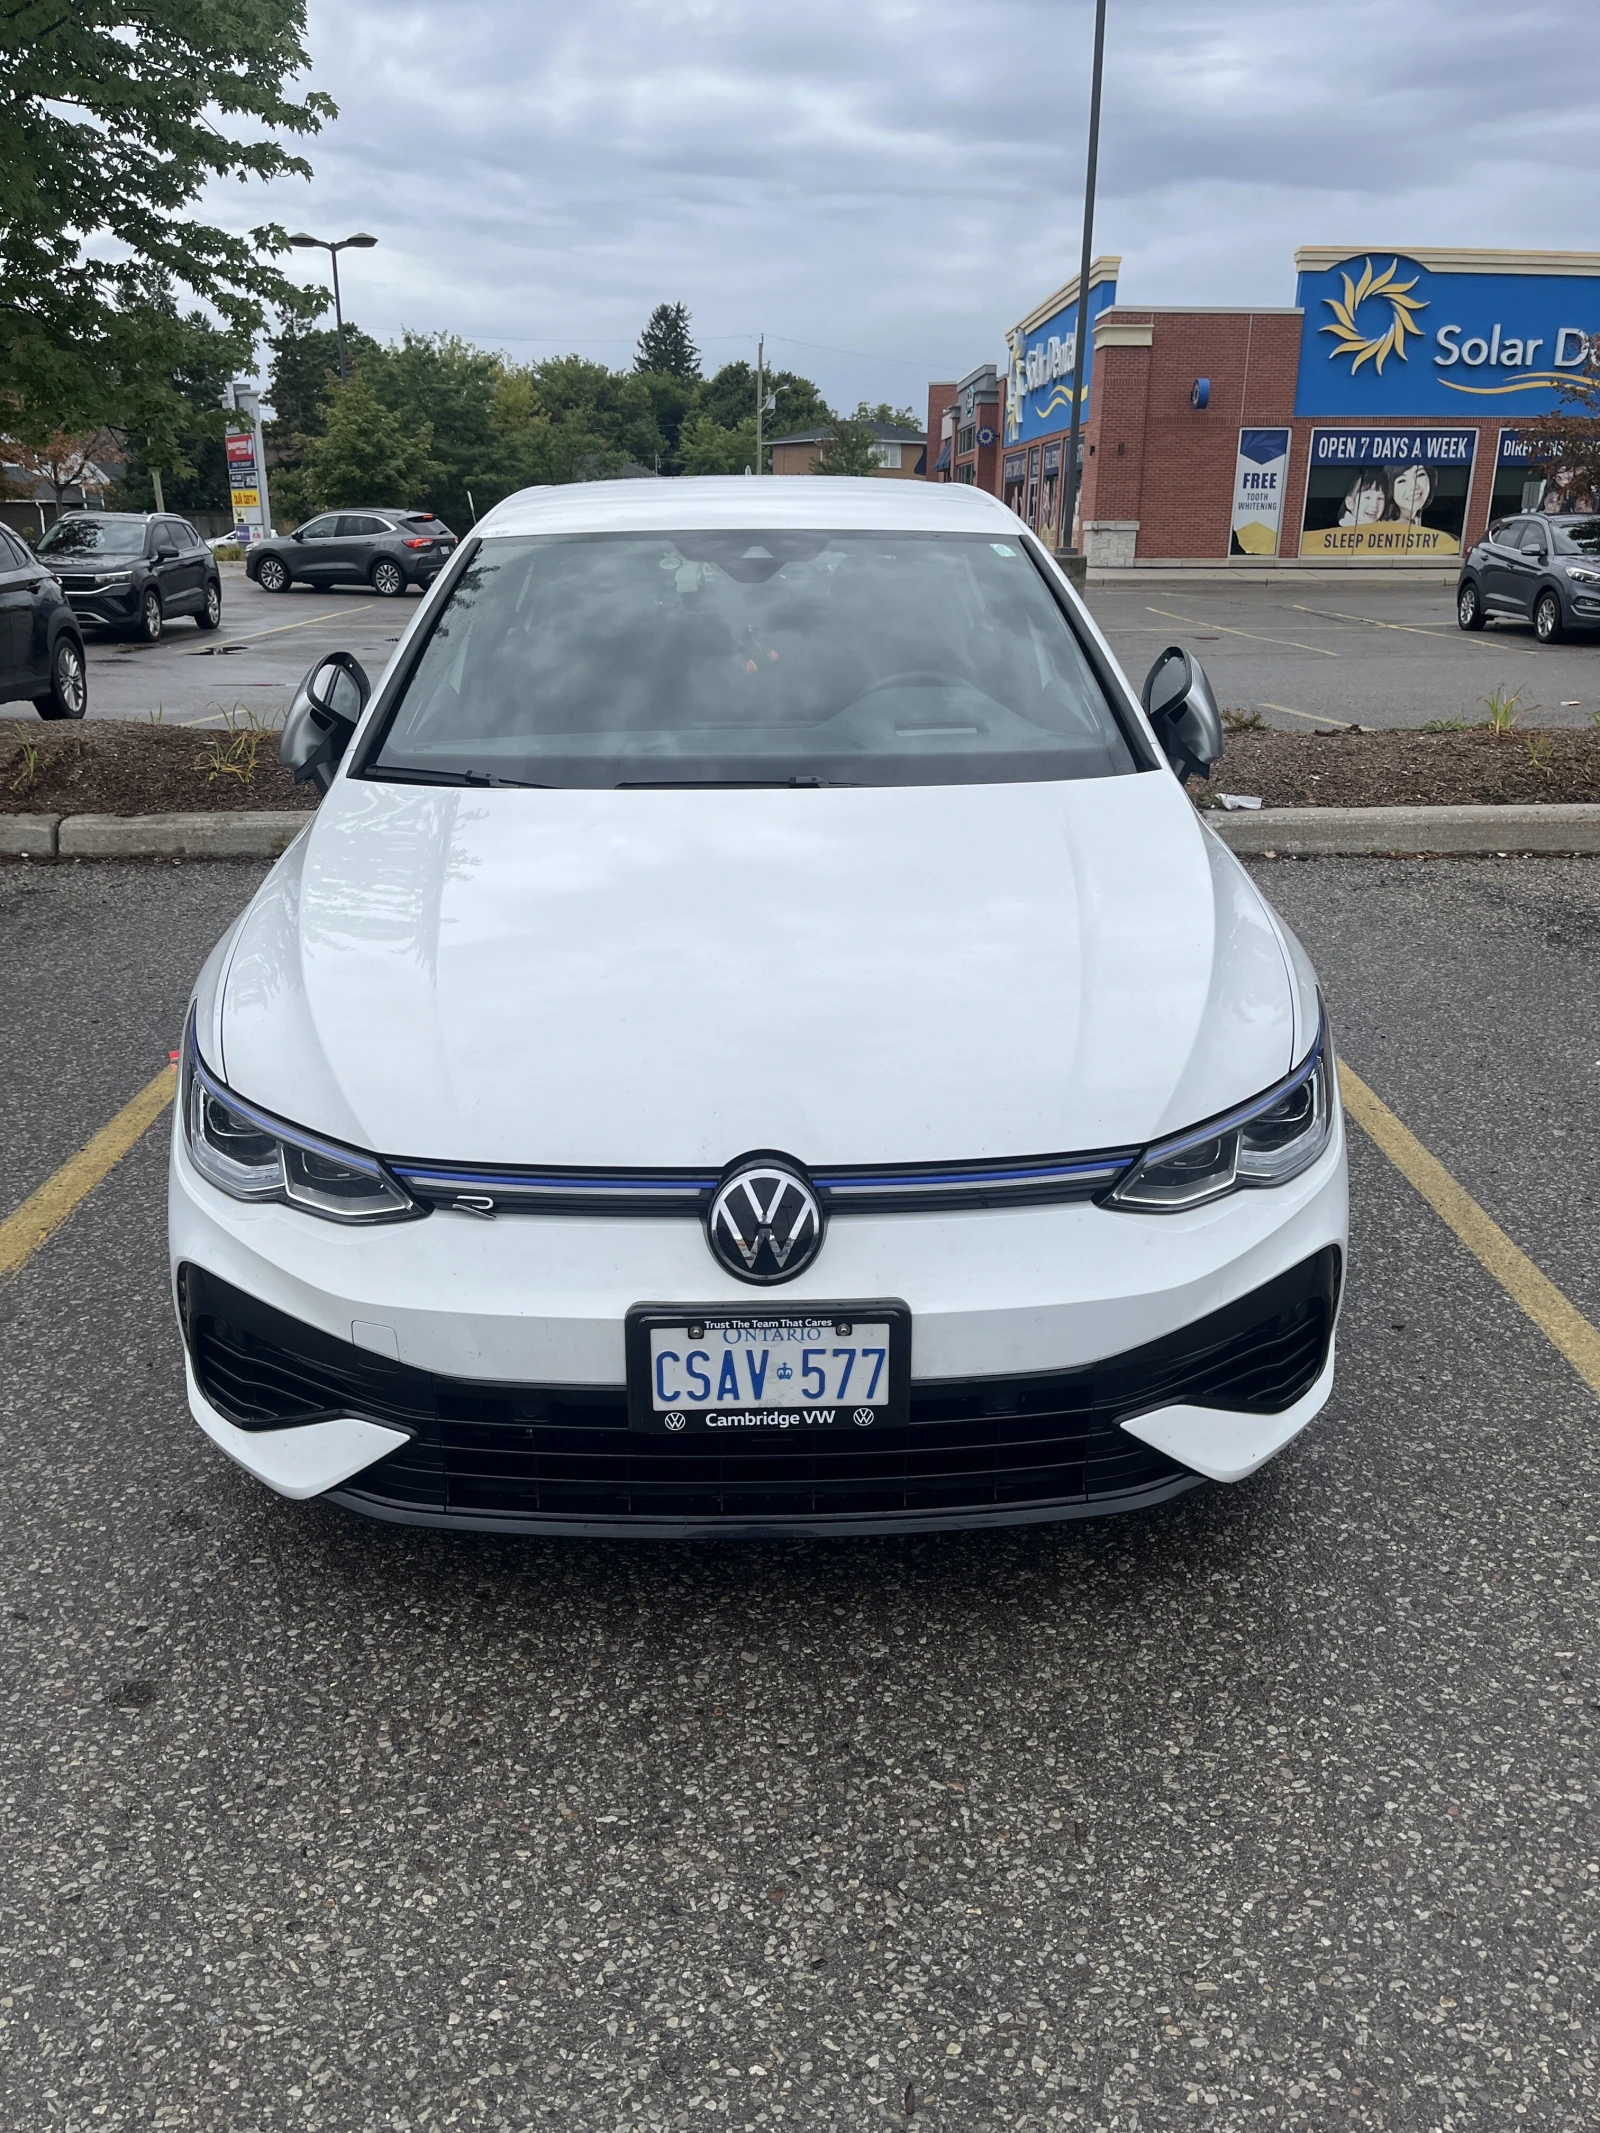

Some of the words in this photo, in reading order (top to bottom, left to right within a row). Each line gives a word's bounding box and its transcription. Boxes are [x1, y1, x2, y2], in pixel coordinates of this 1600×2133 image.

[1433, 323, 1544, 366] Solar
[1553, 327, 1600, 367] D
[1318, 437, 1356, 458] OPEN
[1359, 437, 1371, 458] 7
[1372, 437, 1409, 458] DAYS
[1411, 437, 1422, 458] A
[1427, 437, 1468, 458] WEEK
[1242, 472, 1277, 489] FREE
[1246, 492, 1268, 501] TOOTH
[1237, 502, 1277, 511] WHITENING
[1324, 534, 1364, 548] SLEEP
[1367, 533, 1440, 548] DENTISTRY
[704, 1320, 730, 1329] Trust
[731, 1319, 750, 1328] The
[752, 1319, 778, 1328] Team
[780, 1319, 803, 1328] That
[805, 1318, 832, 1327] Cares
[723, 1327, 821, 1344] ONTARIO
[656, 1349, 769, 1402] CSAV
[801, 1348, 886, 1400] 577
[705, 1411, 800, 1428] Cambridge
[803, 1410, 836, 1424] VW
